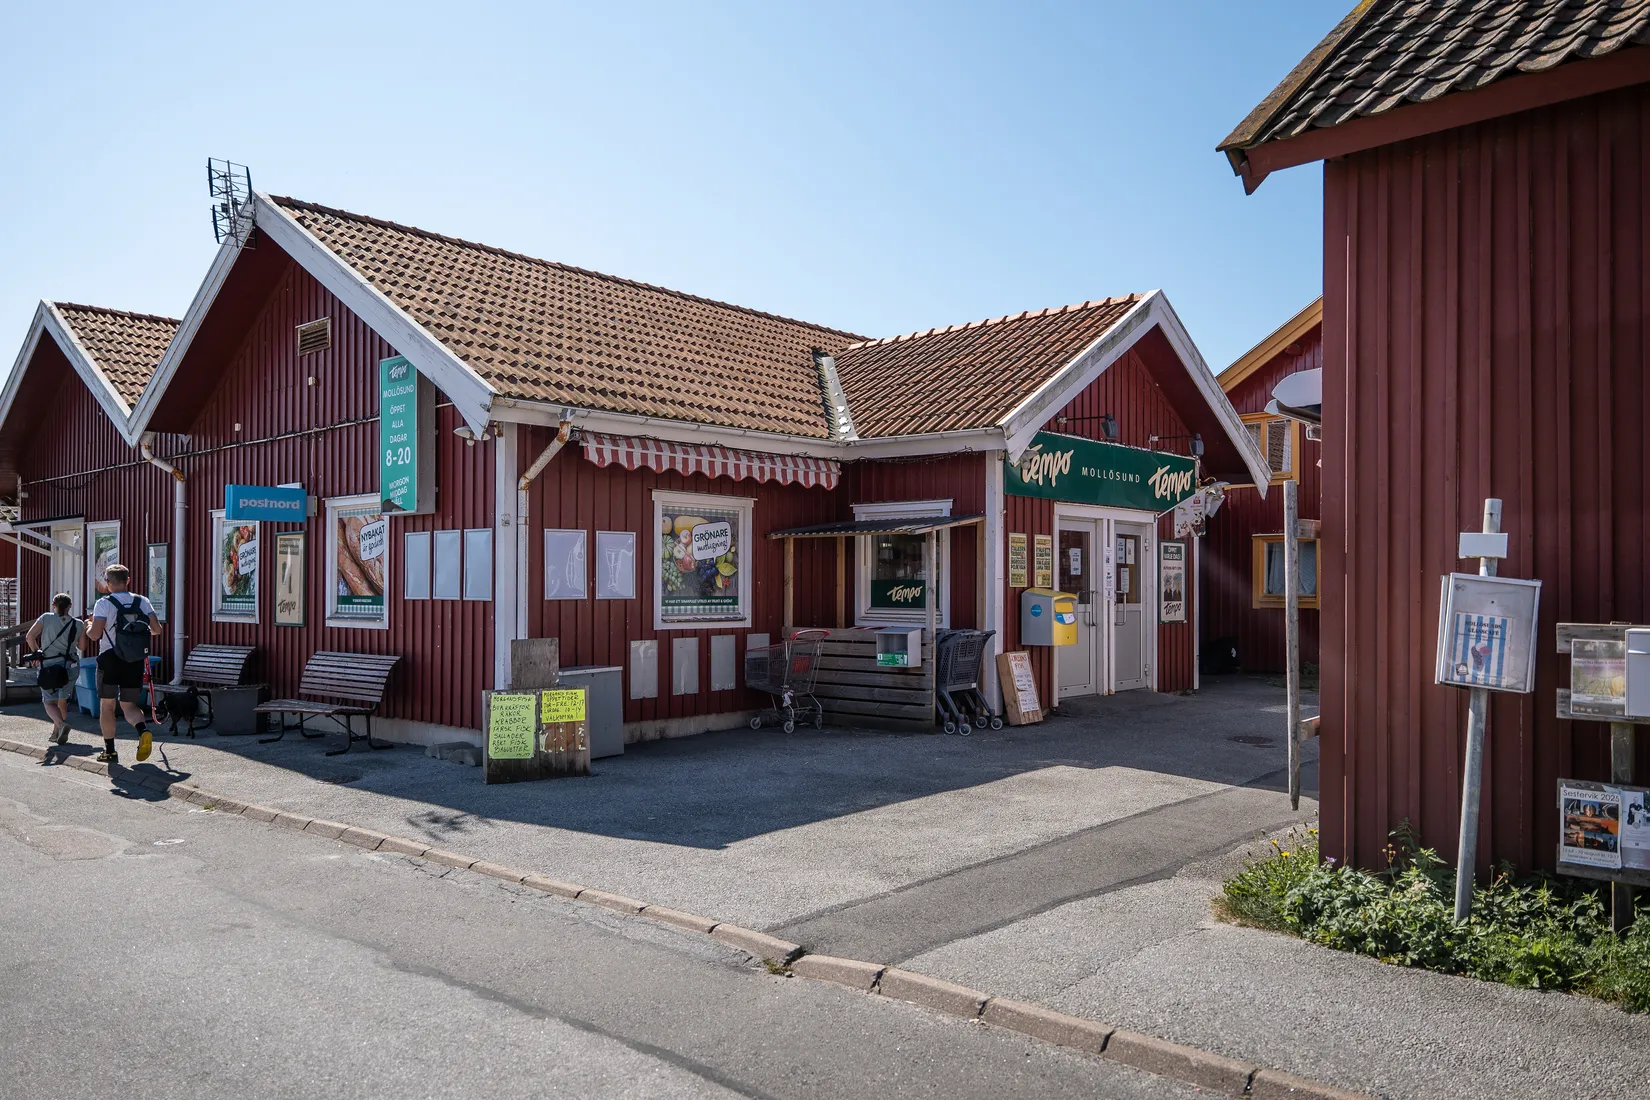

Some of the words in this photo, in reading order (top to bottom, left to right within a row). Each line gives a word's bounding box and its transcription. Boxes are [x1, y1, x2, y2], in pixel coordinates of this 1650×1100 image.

[383, 384, 414, 398] MOLLÖSUND
[390, 404, 406, 414] ÖPPET
[392, 418, 404, 428] ALLA
[390, 433, 408, 444] DAGAR
[386, 446, 410, 466] 8-20
[1082, 466, 1140, 484] MOLLÖSUND
[389, 476, 410, 490] MORGON
[240, 498, 300, 510] postnord
[694, 528, 728, 542] GRÖNARE
[1563, 789, 1598, 800] Sestervik
[1600, 793, 1620, 802] 2025
